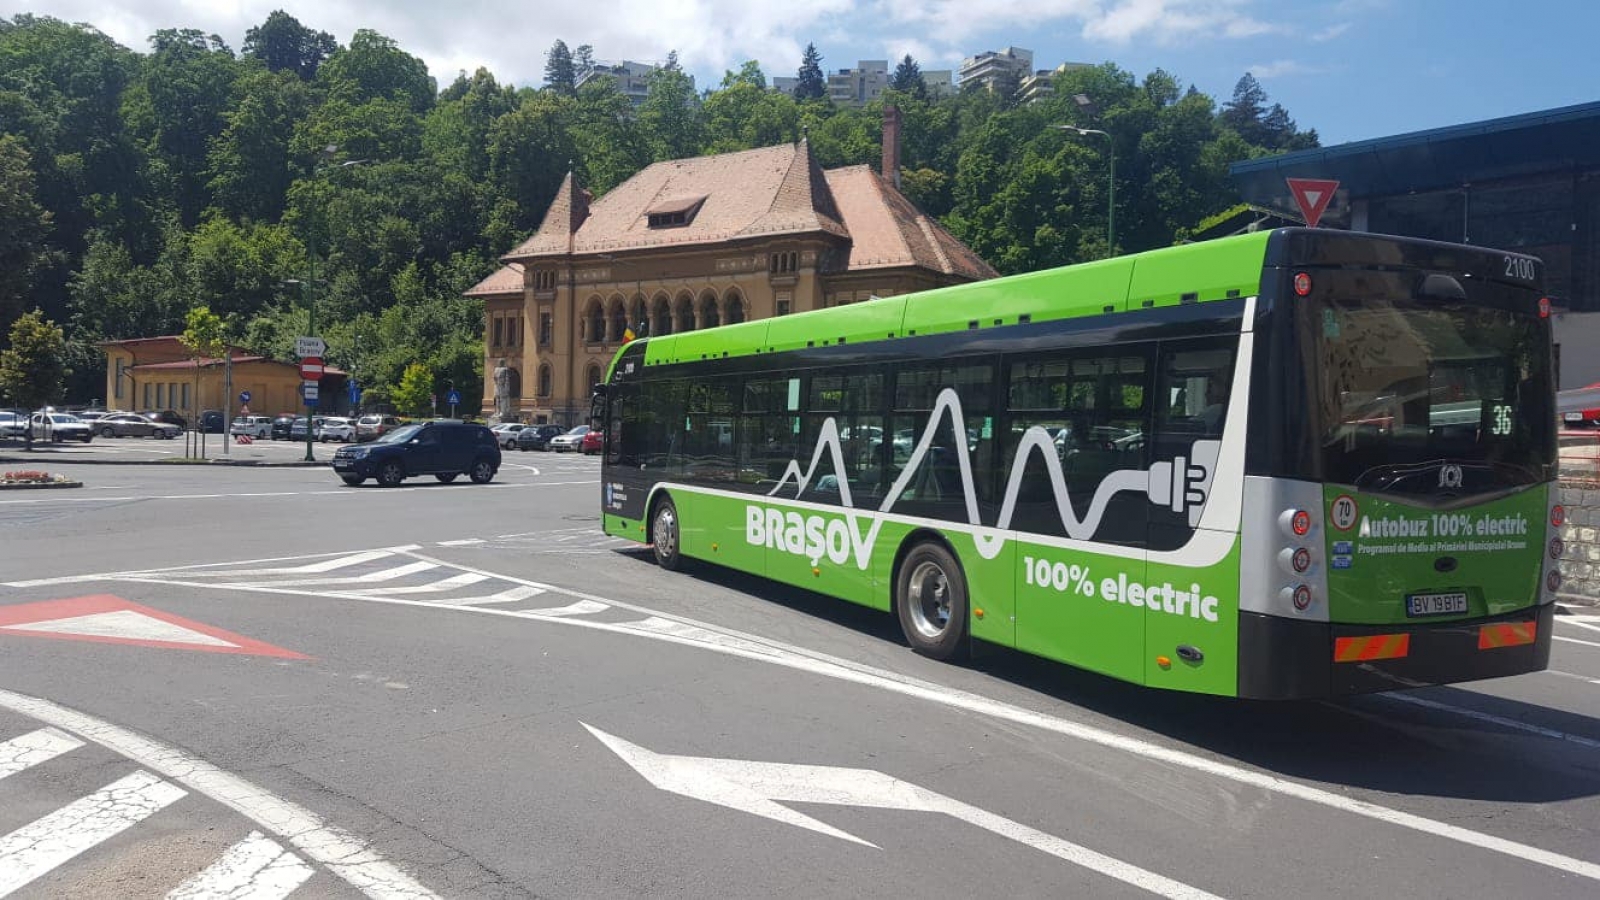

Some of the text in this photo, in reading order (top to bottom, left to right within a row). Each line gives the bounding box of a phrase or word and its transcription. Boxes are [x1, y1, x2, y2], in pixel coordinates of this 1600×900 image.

[1504, 256, 1535, 281] 2100
[1492, 405, 1512, 435] 36
[1339, 501, 1350, 517] 70
[1359, 512, 1527, 538] Autobuz 100% electric
[1023, 556, 1219, 622] 100% electric
[1414, 597, 1429, 613] BV
[1433, 596, 1443, 611] 19
